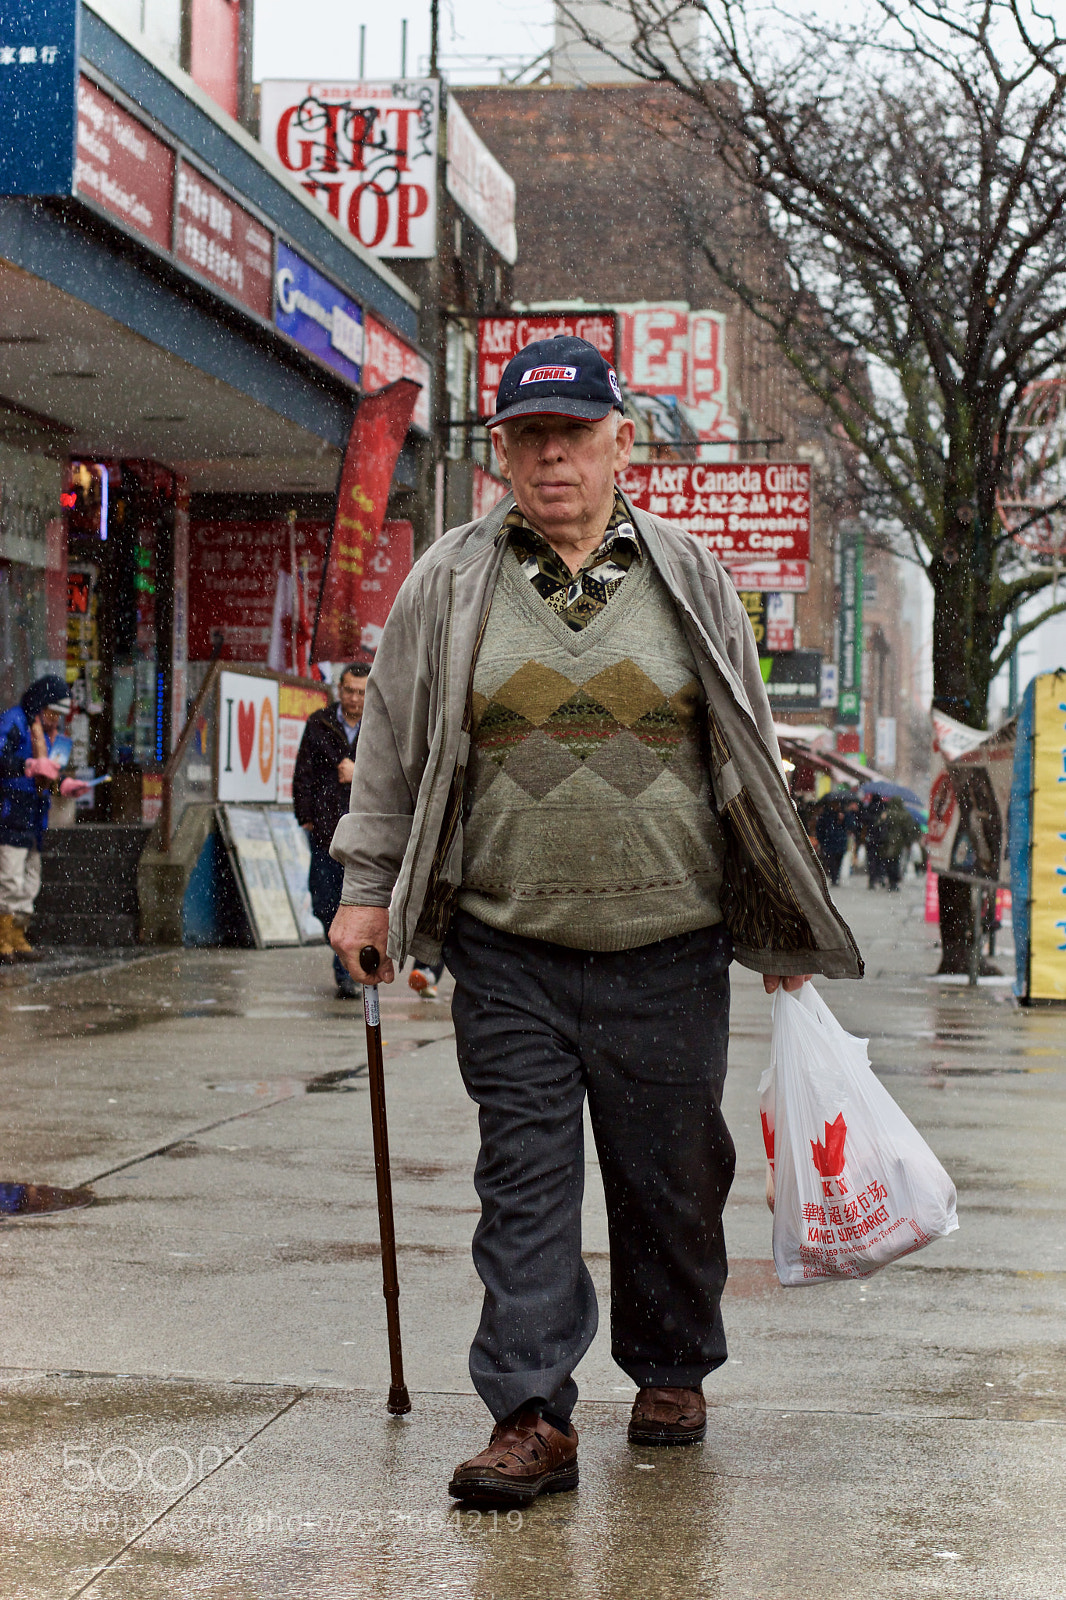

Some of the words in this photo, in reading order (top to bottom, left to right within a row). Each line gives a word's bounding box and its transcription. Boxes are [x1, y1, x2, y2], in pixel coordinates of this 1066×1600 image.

[648, 466, 690, 493] A&F
[691, 466, 762, 493] Canada
[765, 466, 810, 493] Gifts
[666, 514, 725, 532] nadian
[728, 514, 808, 532] Souvenirs
[748, 532, 795, 550] Caps
